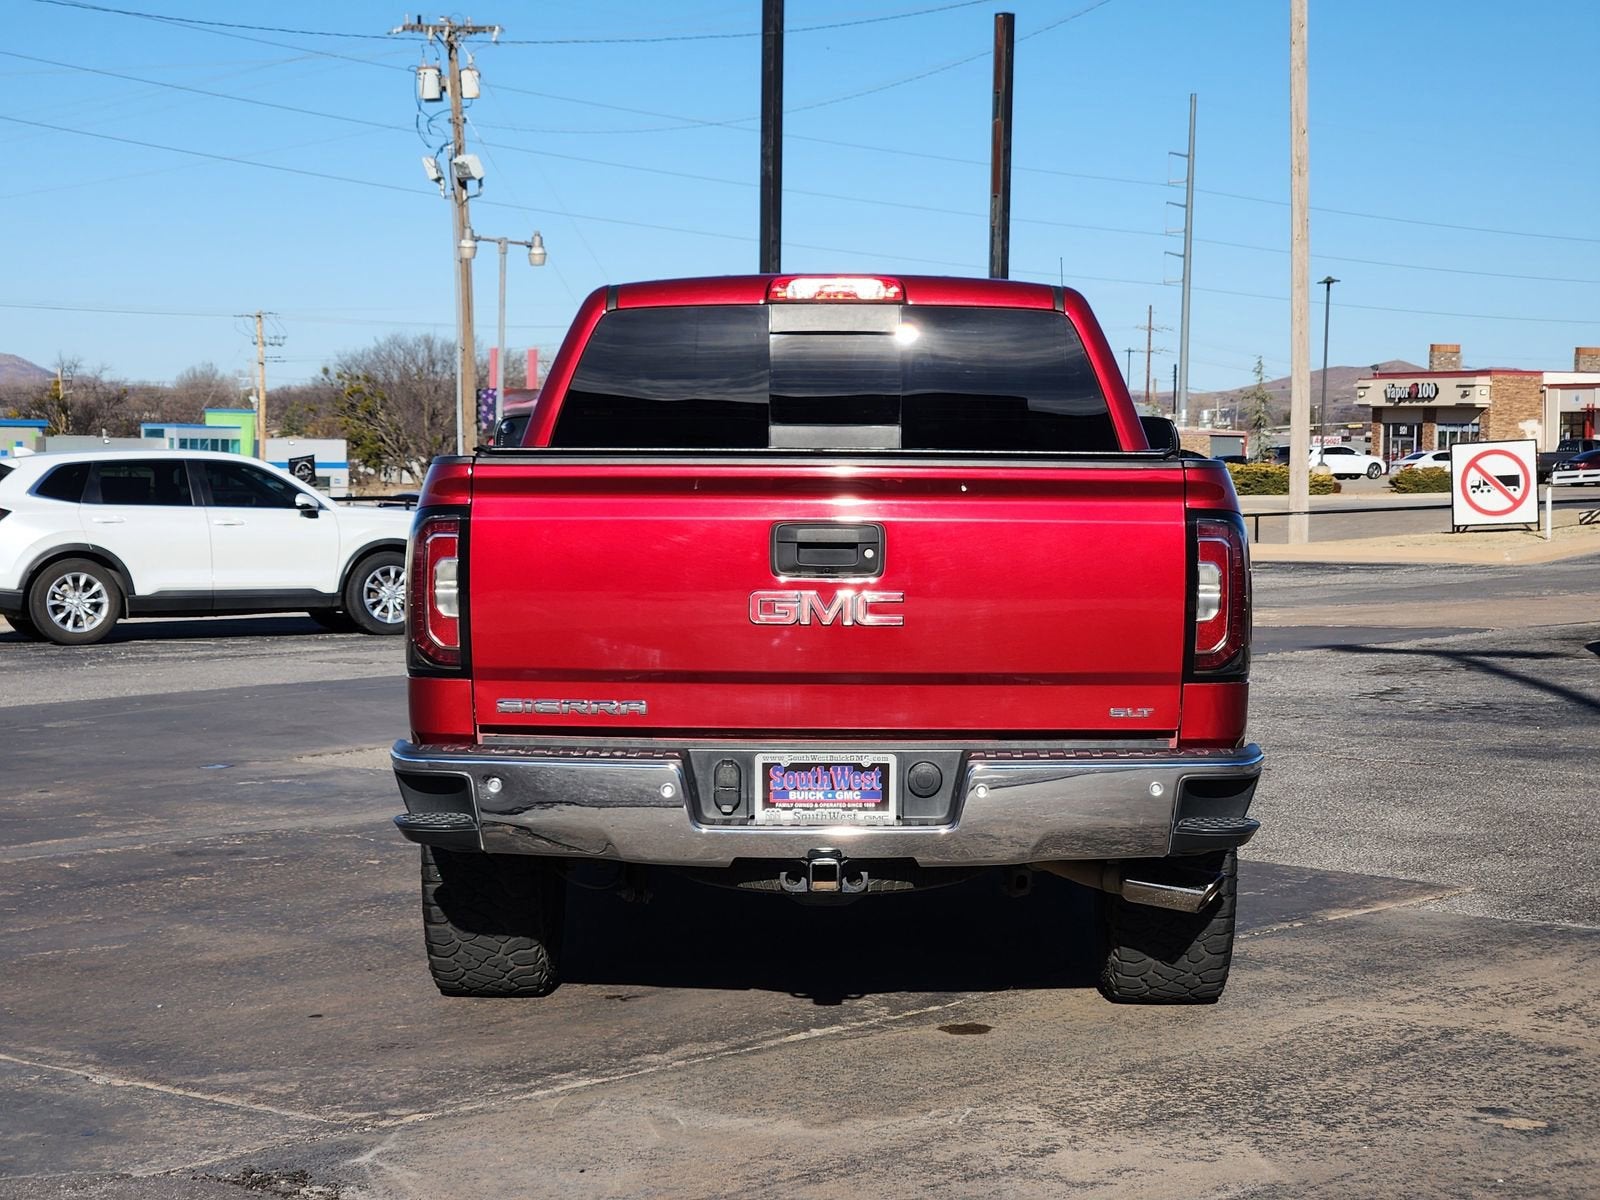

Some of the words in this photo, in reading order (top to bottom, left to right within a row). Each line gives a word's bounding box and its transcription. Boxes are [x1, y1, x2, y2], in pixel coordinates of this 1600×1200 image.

[1386, 383, 1409, 402] Vapor
[1418, 383, 1436, 398] 100
[749, 590, 904, 626] GMC
[496, 698, 648, 715] SIERRA
[1109, 707, 1154, 718] SLT
[788, 791, 825, 800] BUICK
[835, 791, 861, 800] GMC
